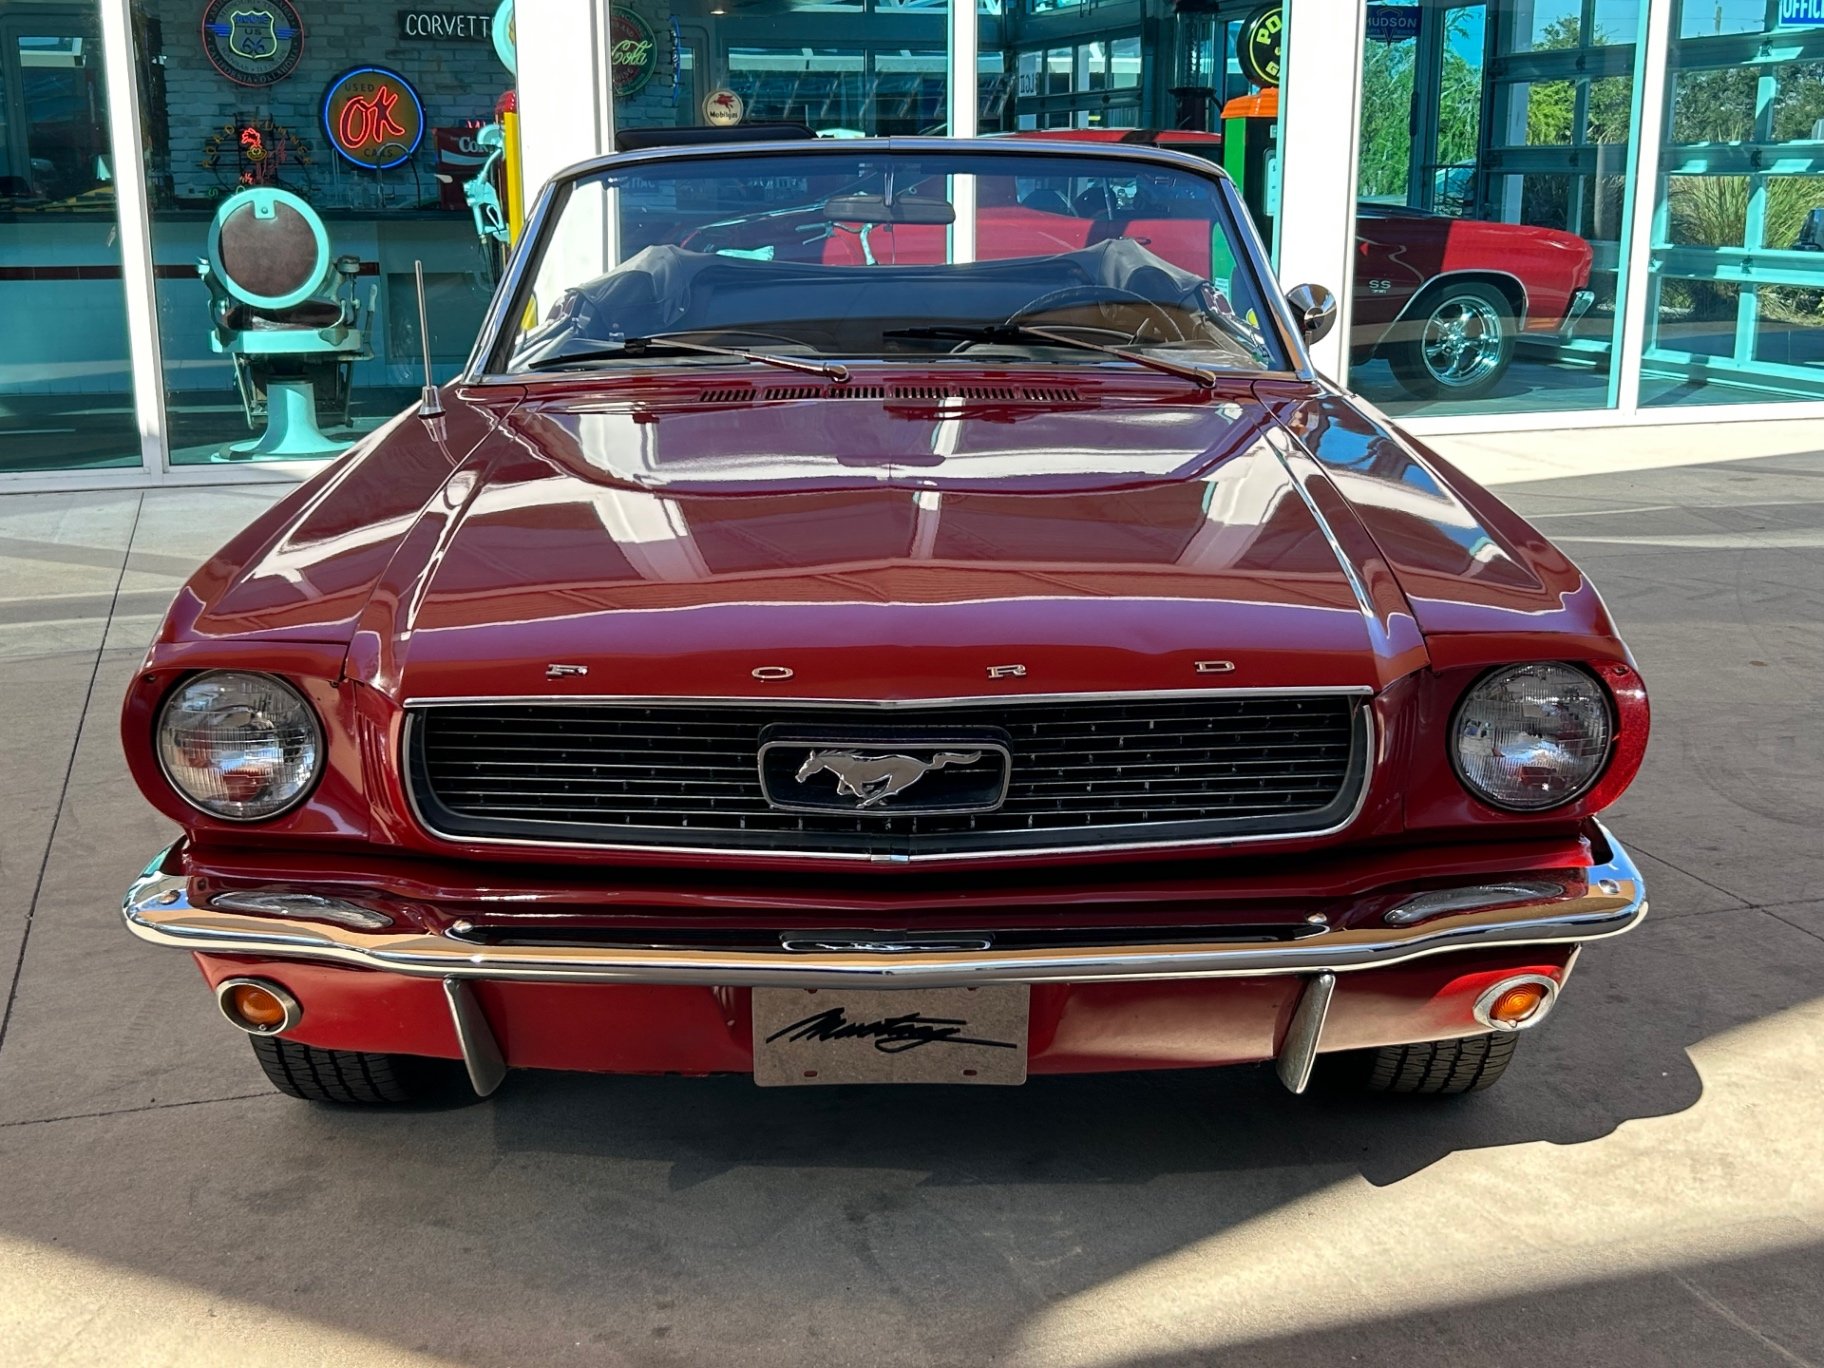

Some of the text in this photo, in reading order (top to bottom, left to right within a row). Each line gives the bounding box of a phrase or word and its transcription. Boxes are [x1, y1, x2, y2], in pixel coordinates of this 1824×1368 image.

[405, 14, 494, 38] CORVETT
[241, 37, 266, 54] 66
[345, 83, 375, 92] USED
[340, 86, 406, 149] OK
[710, 111, 738, 120] Mobilgas
[1368, 279, 1391, 289] SS
[546, 661, 1236, 681] FORD
[766, 1007, 1018, 1054] Mustang
